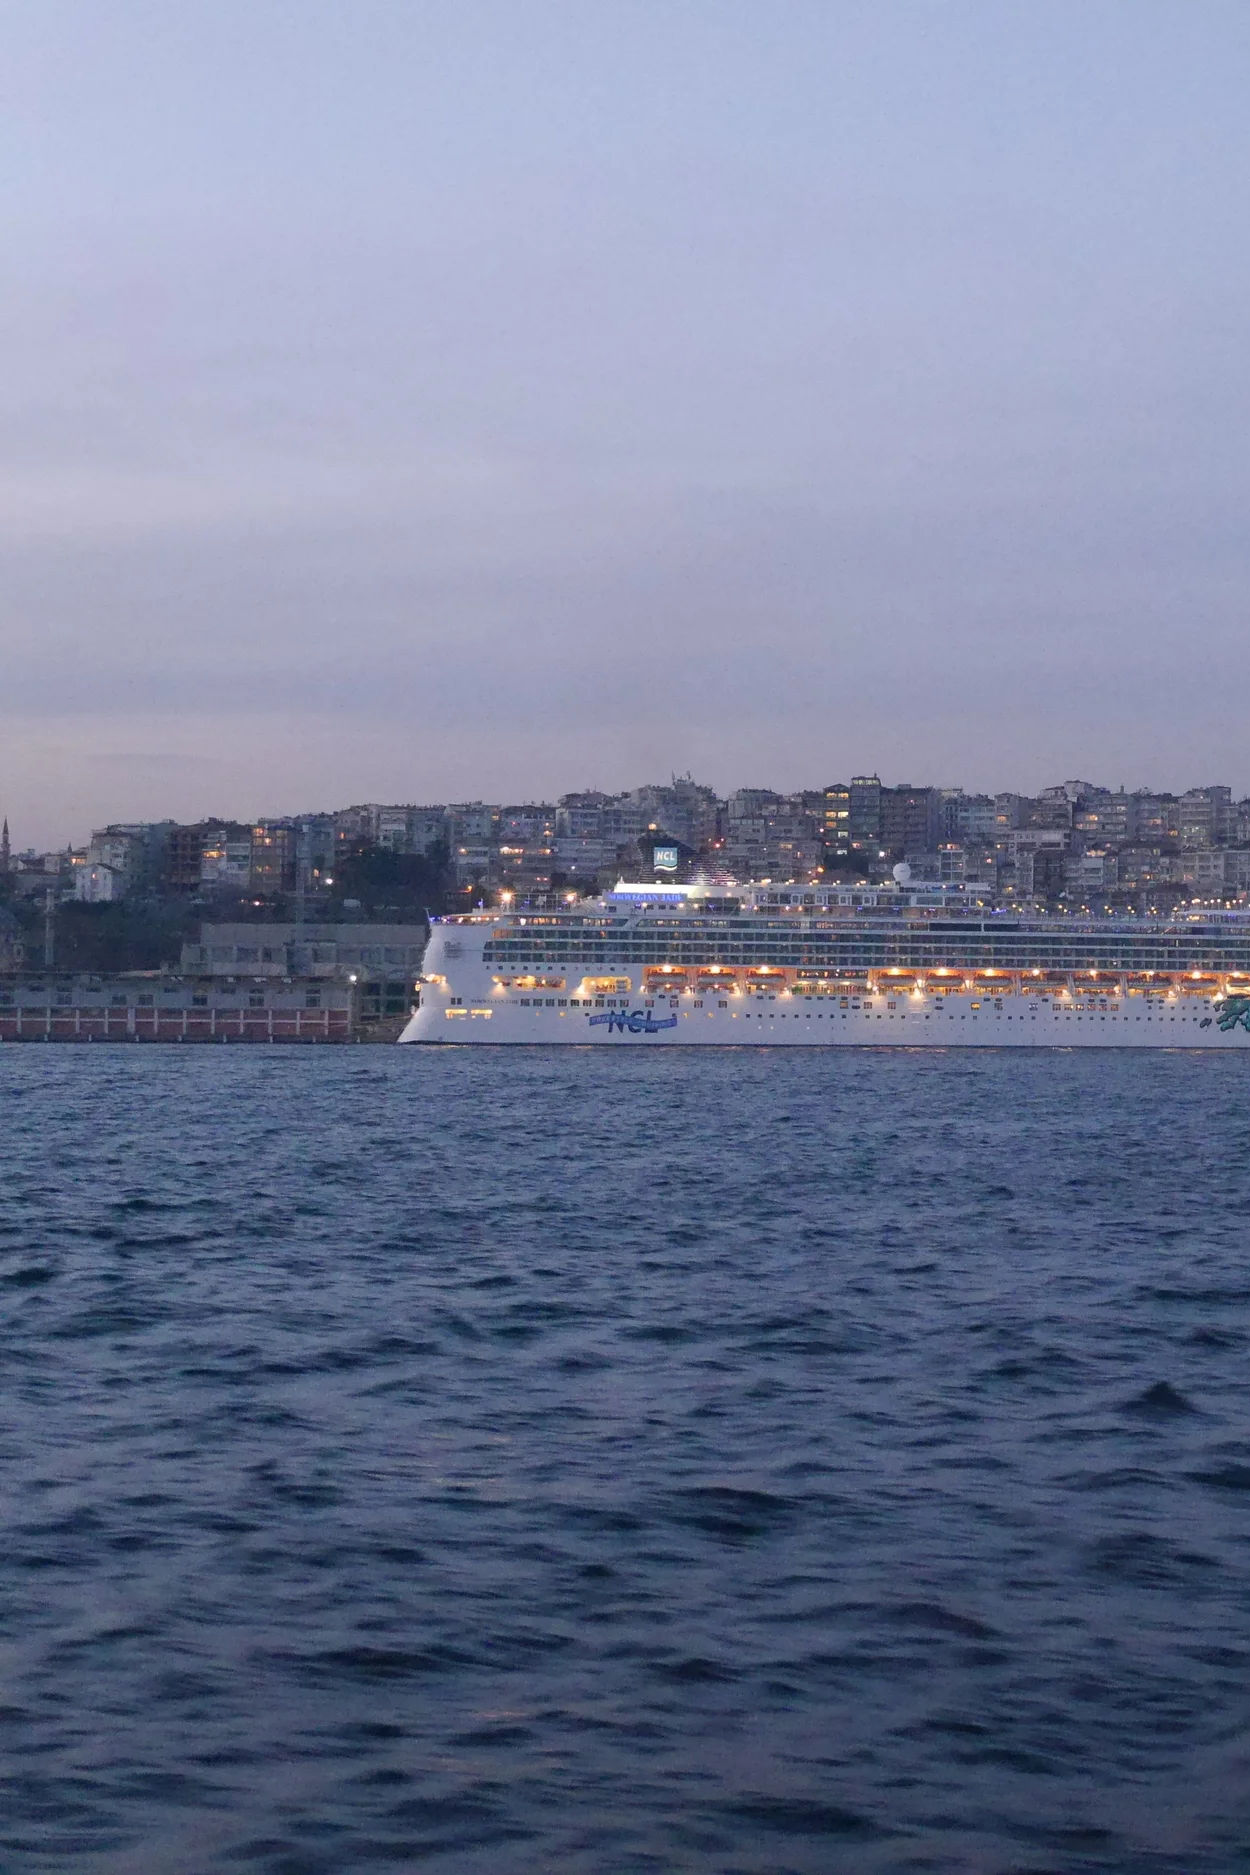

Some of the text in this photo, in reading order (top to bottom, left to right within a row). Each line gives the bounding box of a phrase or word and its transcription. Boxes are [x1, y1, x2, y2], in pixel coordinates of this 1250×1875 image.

[656, 851, 675, 861] NCL
[608, 893, 683, 901] NORWEGIAN JADE
[608, 1010, 658, 1033] NCL
